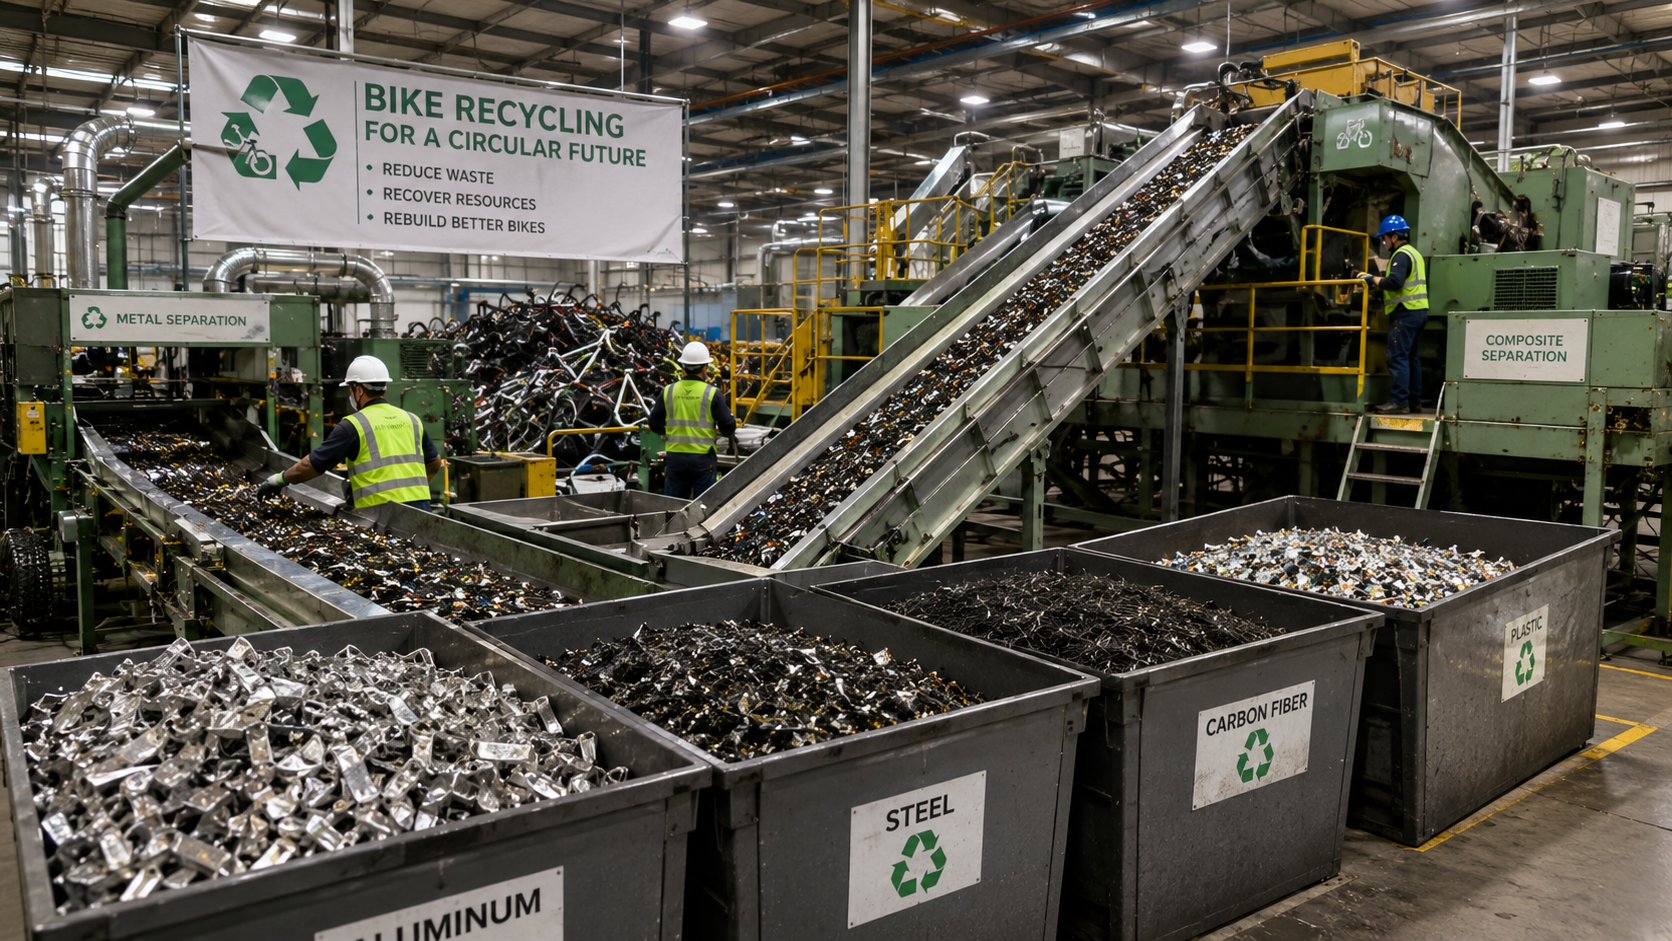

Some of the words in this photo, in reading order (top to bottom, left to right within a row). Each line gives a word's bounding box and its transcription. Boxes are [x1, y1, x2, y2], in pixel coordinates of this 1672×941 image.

[365, 83, 443, 118] BIKE
[455, 93, 624, 139] RECYCLING
[365, 120, 416, 146] FOR
[423, 127, 441, 149] A
[448, 129, 562, 160] CIRCULAR
[568, 142, 647, 168] FUTURE
[382, 162, 442, 181] REDUCE
[445, 167, 494, 185] WASTE
[383, 186, 452, 205] RECOVER
[456, 192, 537, 211] RESOURCES
[383, 211, 447, 228] REBUILD
[451, 215, 504, 232] BETTER
[507, 219, 546, 234] BIKES
[116, 313, 163, 326] METAL
[166, 313, 247, 327] SEPARATION
[1485, 335, 1563, 346] COMPOSITE
[1482, 350, 1567, 362] SEPARATION
[1511, 616, 1542, 644] PLASTIC
[1205, 703, 1268, 737] CARBON
[1271, 693, 1307, 717] FIBER
[886, 794, 954, 831] STEEL
[355, 887, 541, 941] UMINUM
